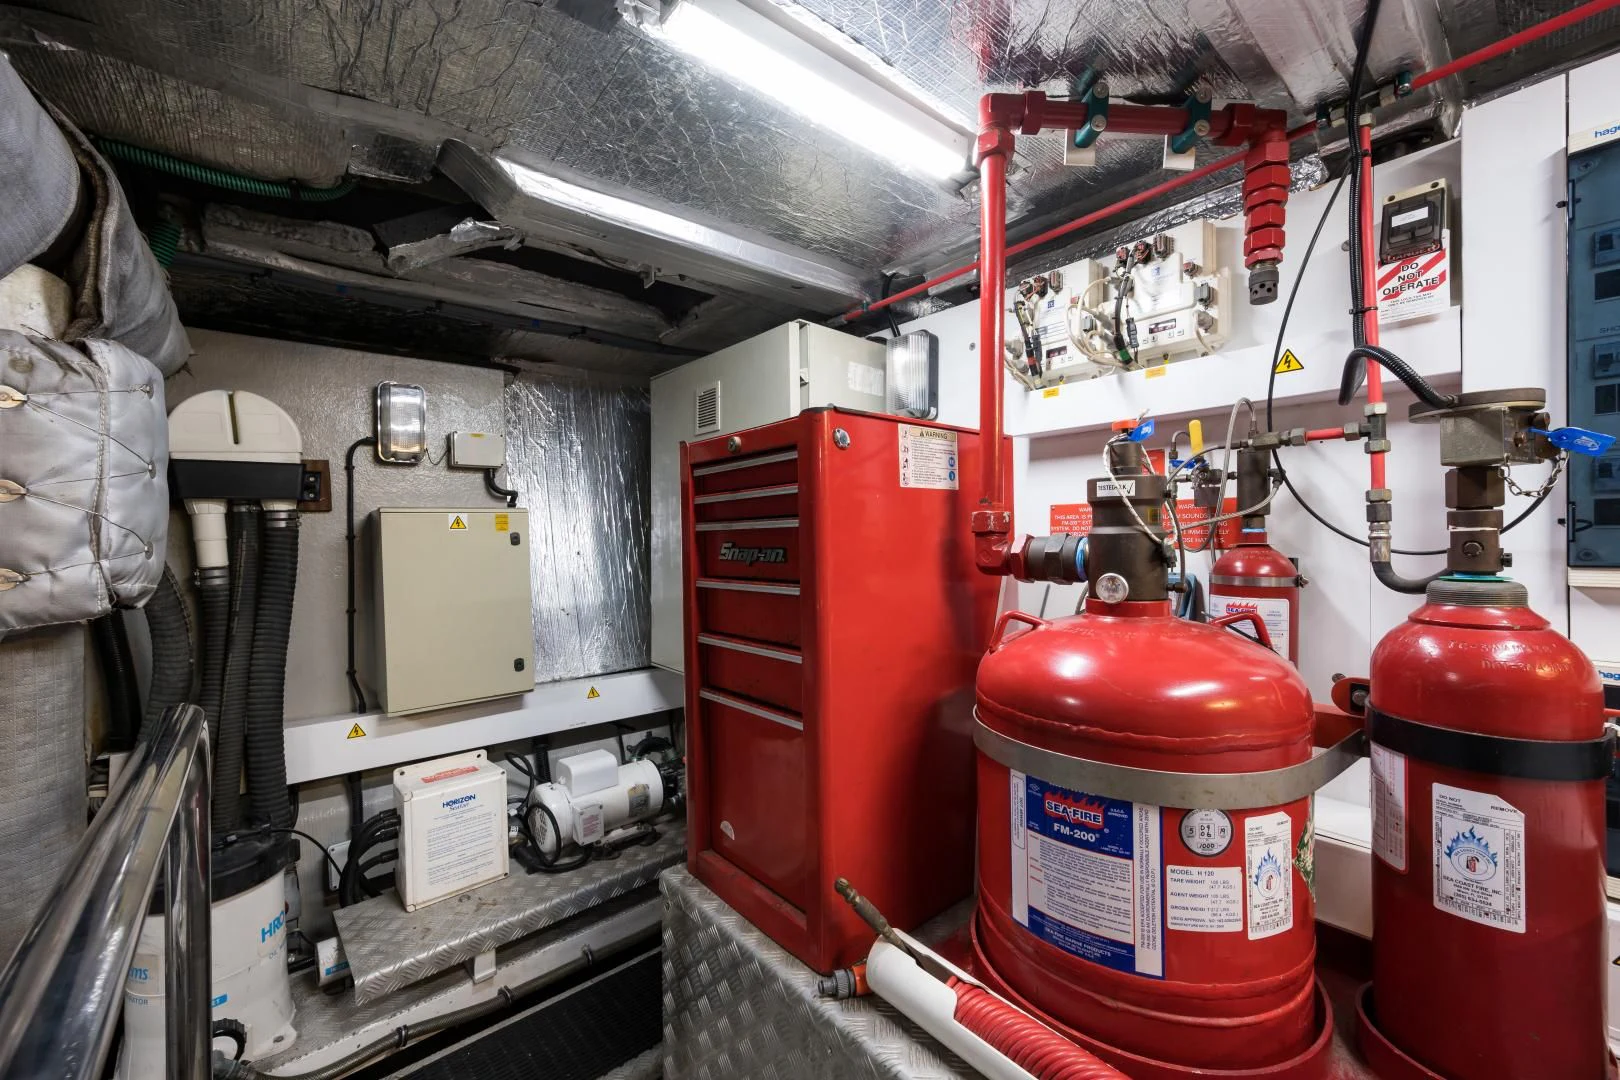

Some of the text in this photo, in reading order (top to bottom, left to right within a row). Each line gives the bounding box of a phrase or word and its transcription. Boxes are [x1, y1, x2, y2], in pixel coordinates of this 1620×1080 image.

[1402, 263, 1419, 271] DO
[1398, 271, 1422, 282] NOT
[1383, 277, 1438, 295] OPERATE
[925, 431, 947, 439] WARNING
[443, 794, 475, 808] HORIZON
[1046, 800, 1102, 824] SEA-FIRE
[1455, 879, 1474, 888] COAST
